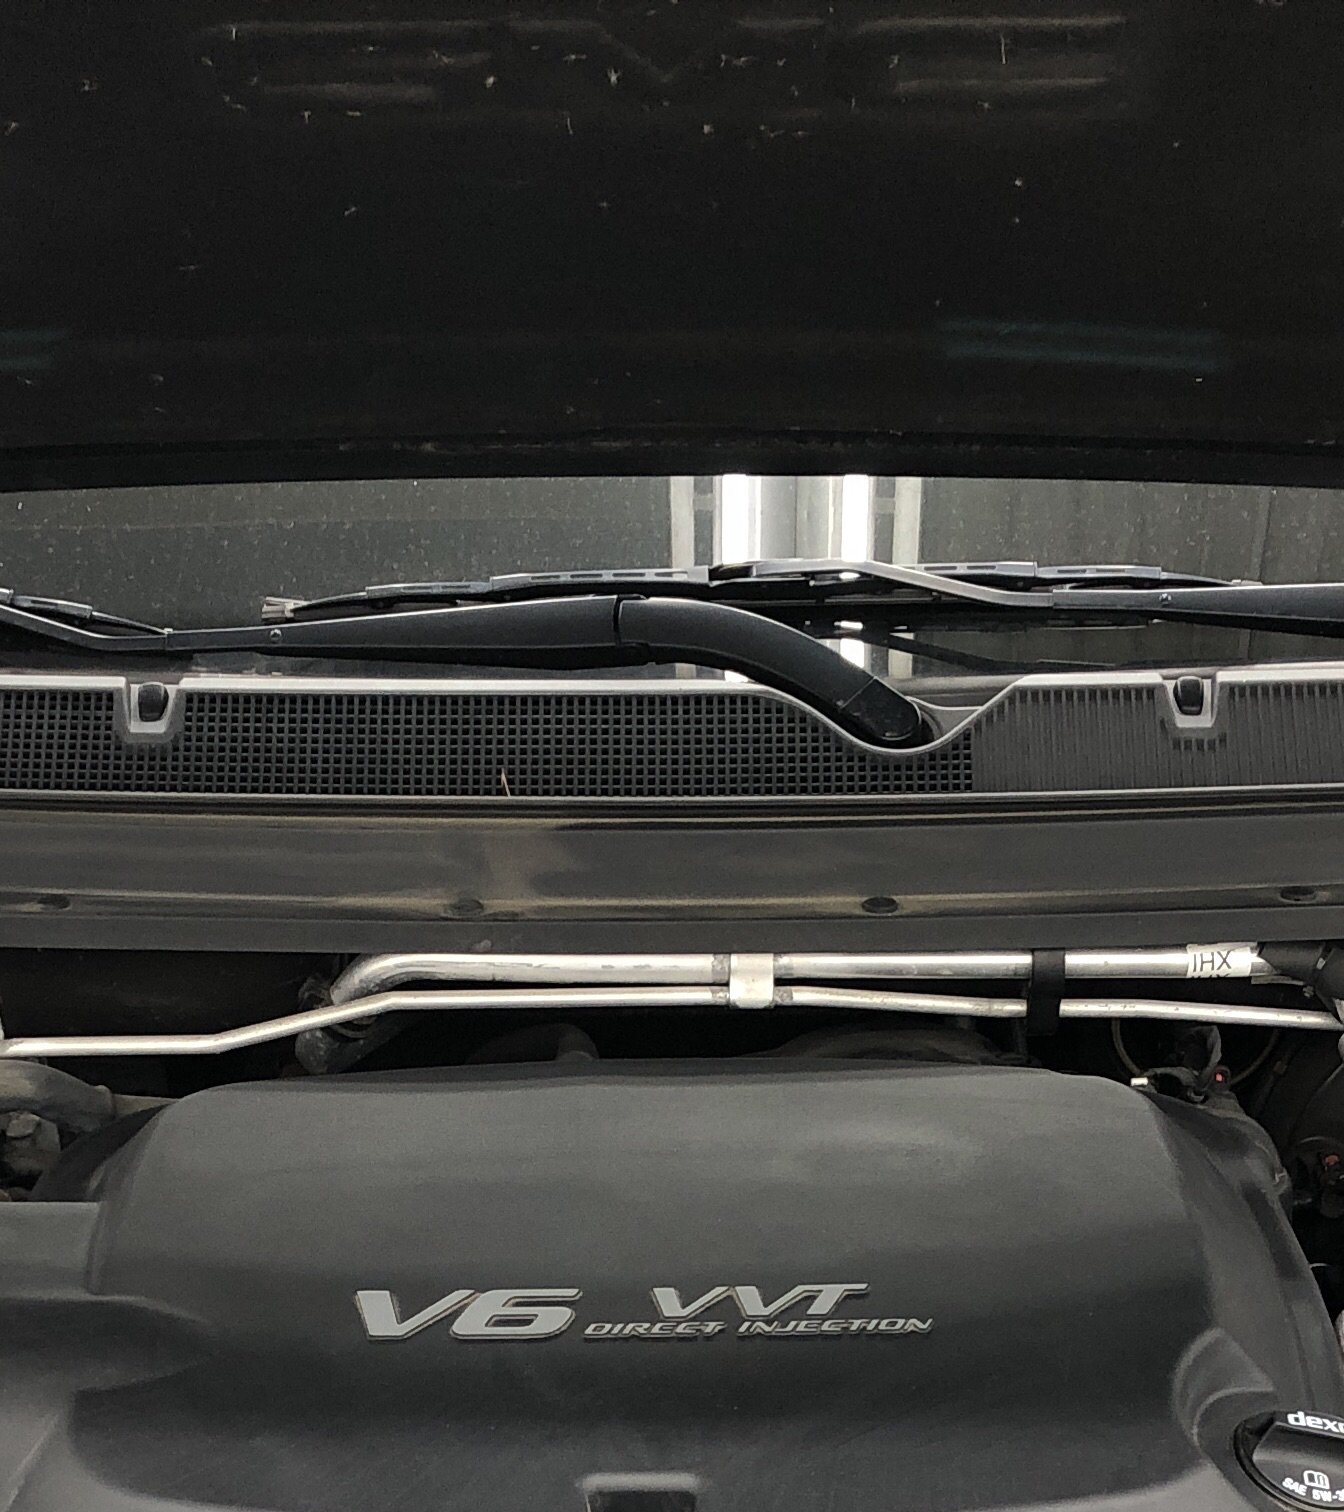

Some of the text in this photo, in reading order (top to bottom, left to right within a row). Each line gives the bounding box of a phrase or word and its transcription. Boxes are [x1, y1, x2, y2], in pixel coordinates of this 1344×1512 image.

[1193, 950, 1232, 972] IHX
[650, 1282, 870, 1320] VVT
[354, 1287, 582, 1341] V6
[584, 1316, 932, 1339] DIRECT INJECTION
[1282, 1477, 1308, 1497] SAE
